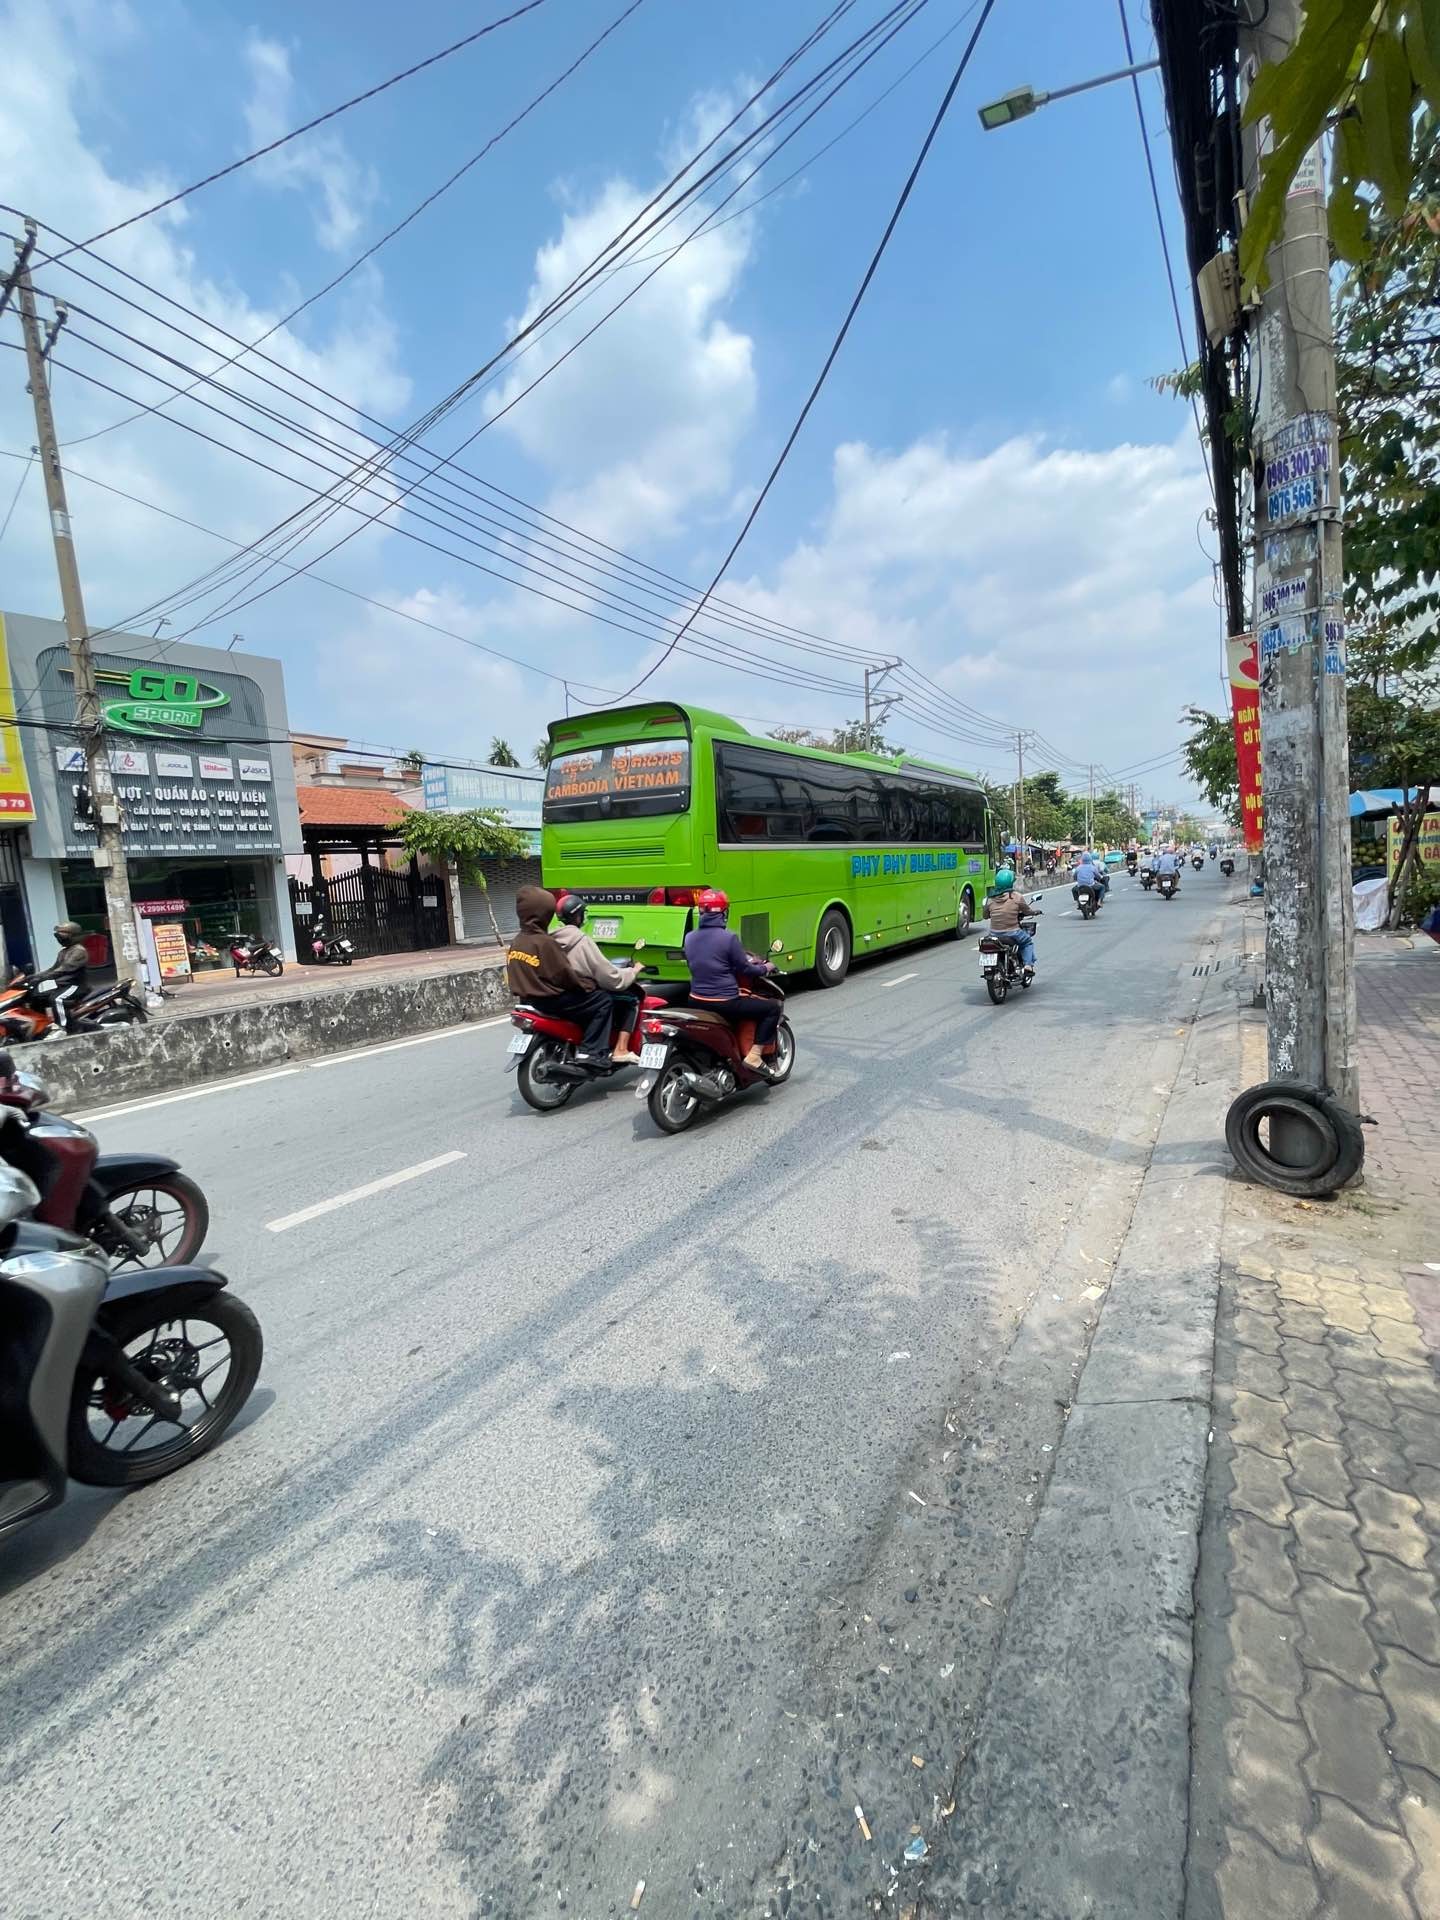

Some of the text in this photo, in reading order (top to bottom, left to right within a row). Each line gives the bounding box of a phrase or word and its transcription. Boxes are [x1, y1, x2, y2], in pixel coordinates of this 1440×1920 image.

[129, 668, 198, 701] GO
[134, 706, 197, 724] SPORT
[118, 786, 141, 801] VỢT
[191, 786, 207, 801] ÁO
[217, 790, 240, 804] PHỤ
[241, 789, 267, 806] KIỆN
[548, 770, 680, 800] CAMBODIA VIETNAM
[852, 855, 880, 878] PHY
[883, 853, 907, 875] PHY
